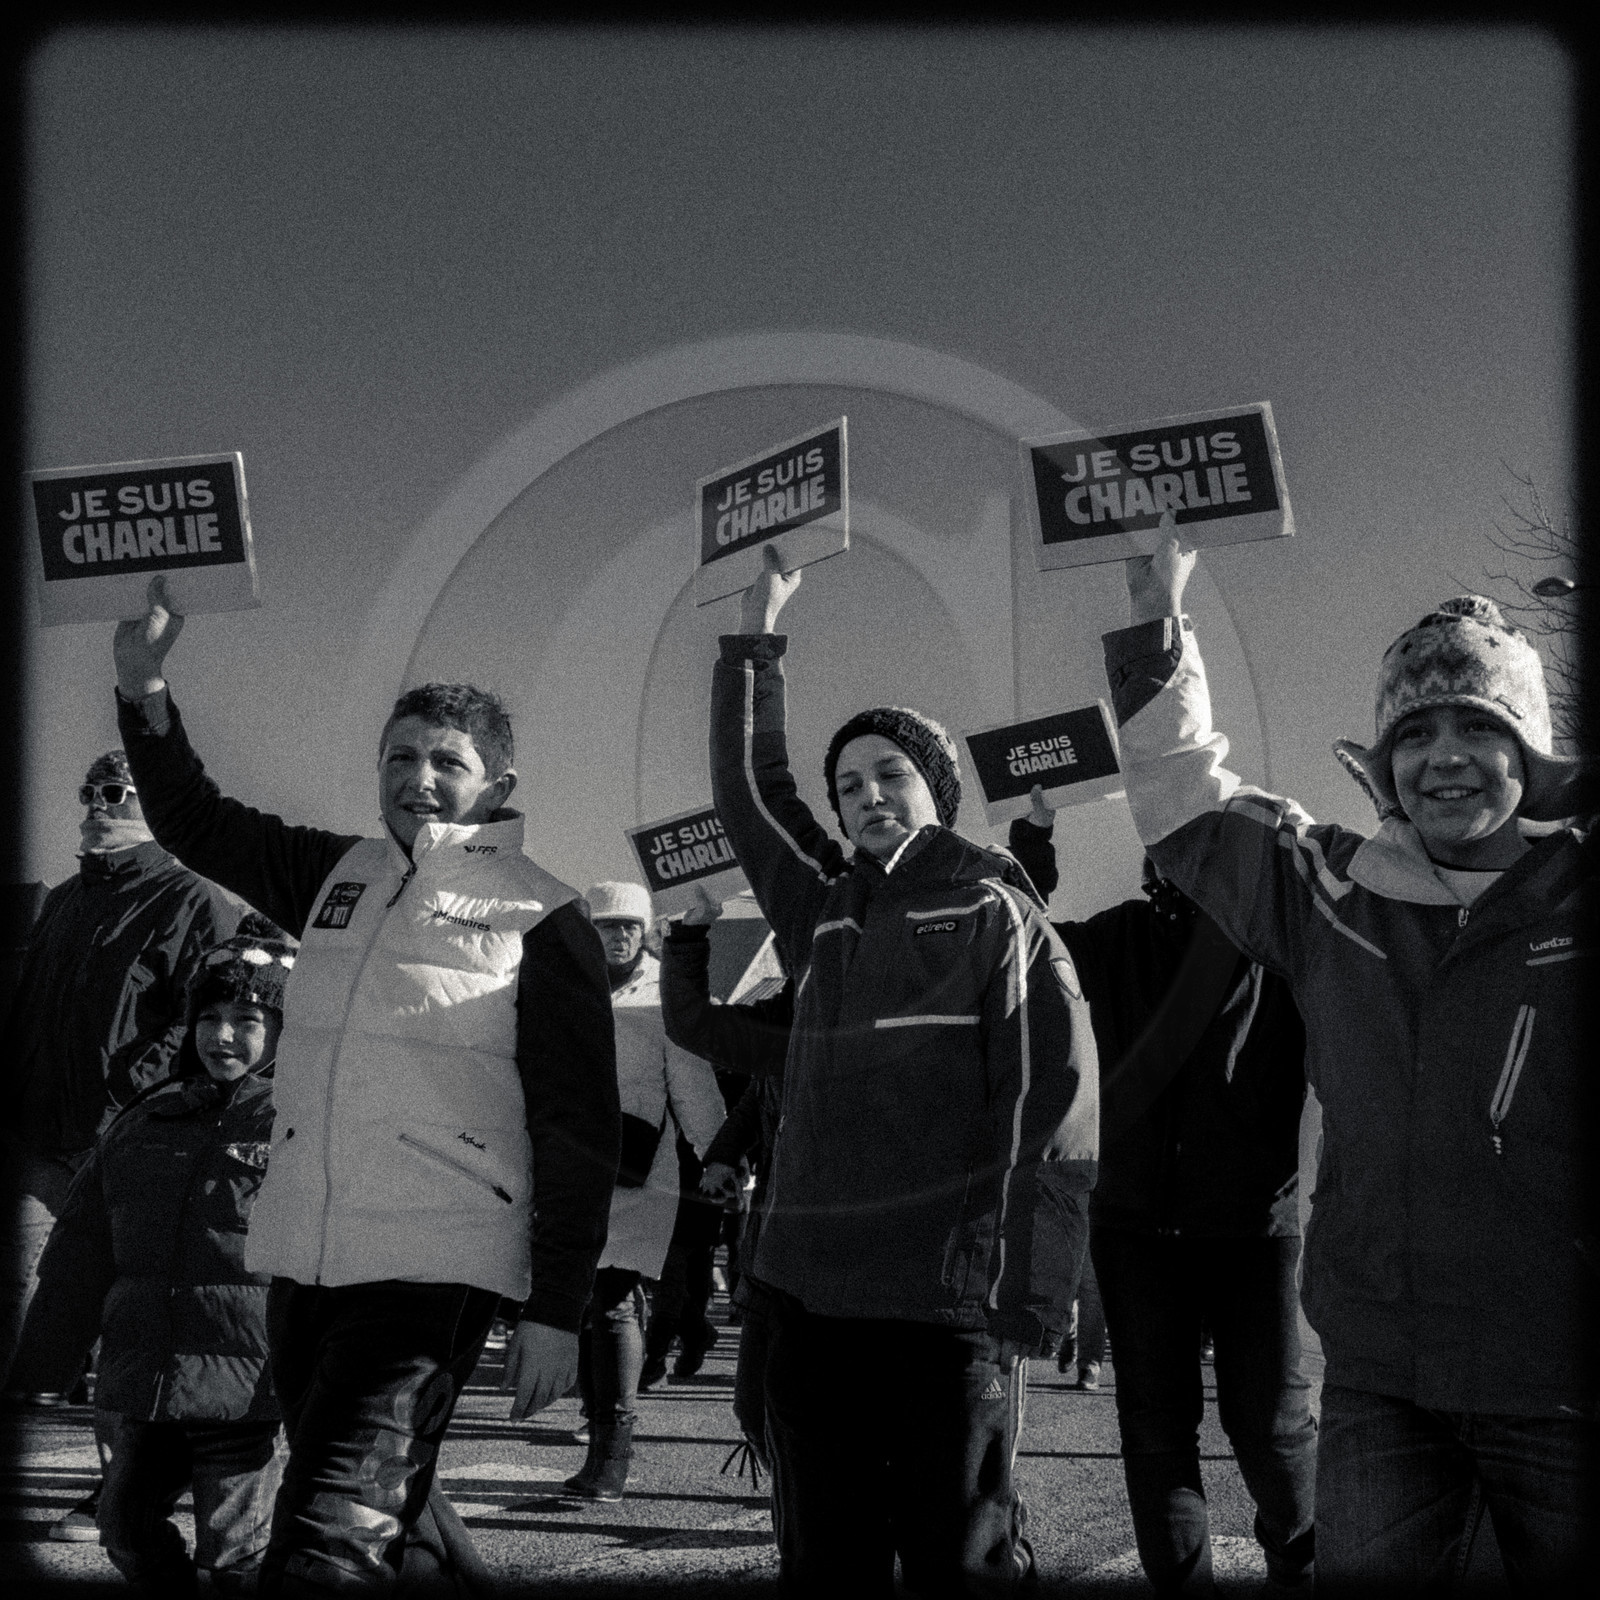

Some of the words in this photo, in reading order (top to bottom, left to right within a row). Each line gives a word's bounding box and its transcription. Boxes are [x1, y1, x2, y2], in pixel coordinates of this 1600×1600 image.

[716, 477, 752, 512] JE
[756, 447, 825, 495] SUIS
[1060, 449, 1121, 483] JE
[1129, 431, 1242, 472] SUIS
[57, 488, 111, 521] JE
[116, 478, 215, 515] SUIS
[715, 473, 826, 546] CHARLIE
[1064, 462, 1253, 525] CHARLIE
[62, 512, 223, 565] CHARLIE
[1005, 744, 1029, 761] JE
[1029, 735, 1072, 755] SUIS
[1008, 747, 1079, 777] CHARLIE
[649, 831, 679, 856] JE
